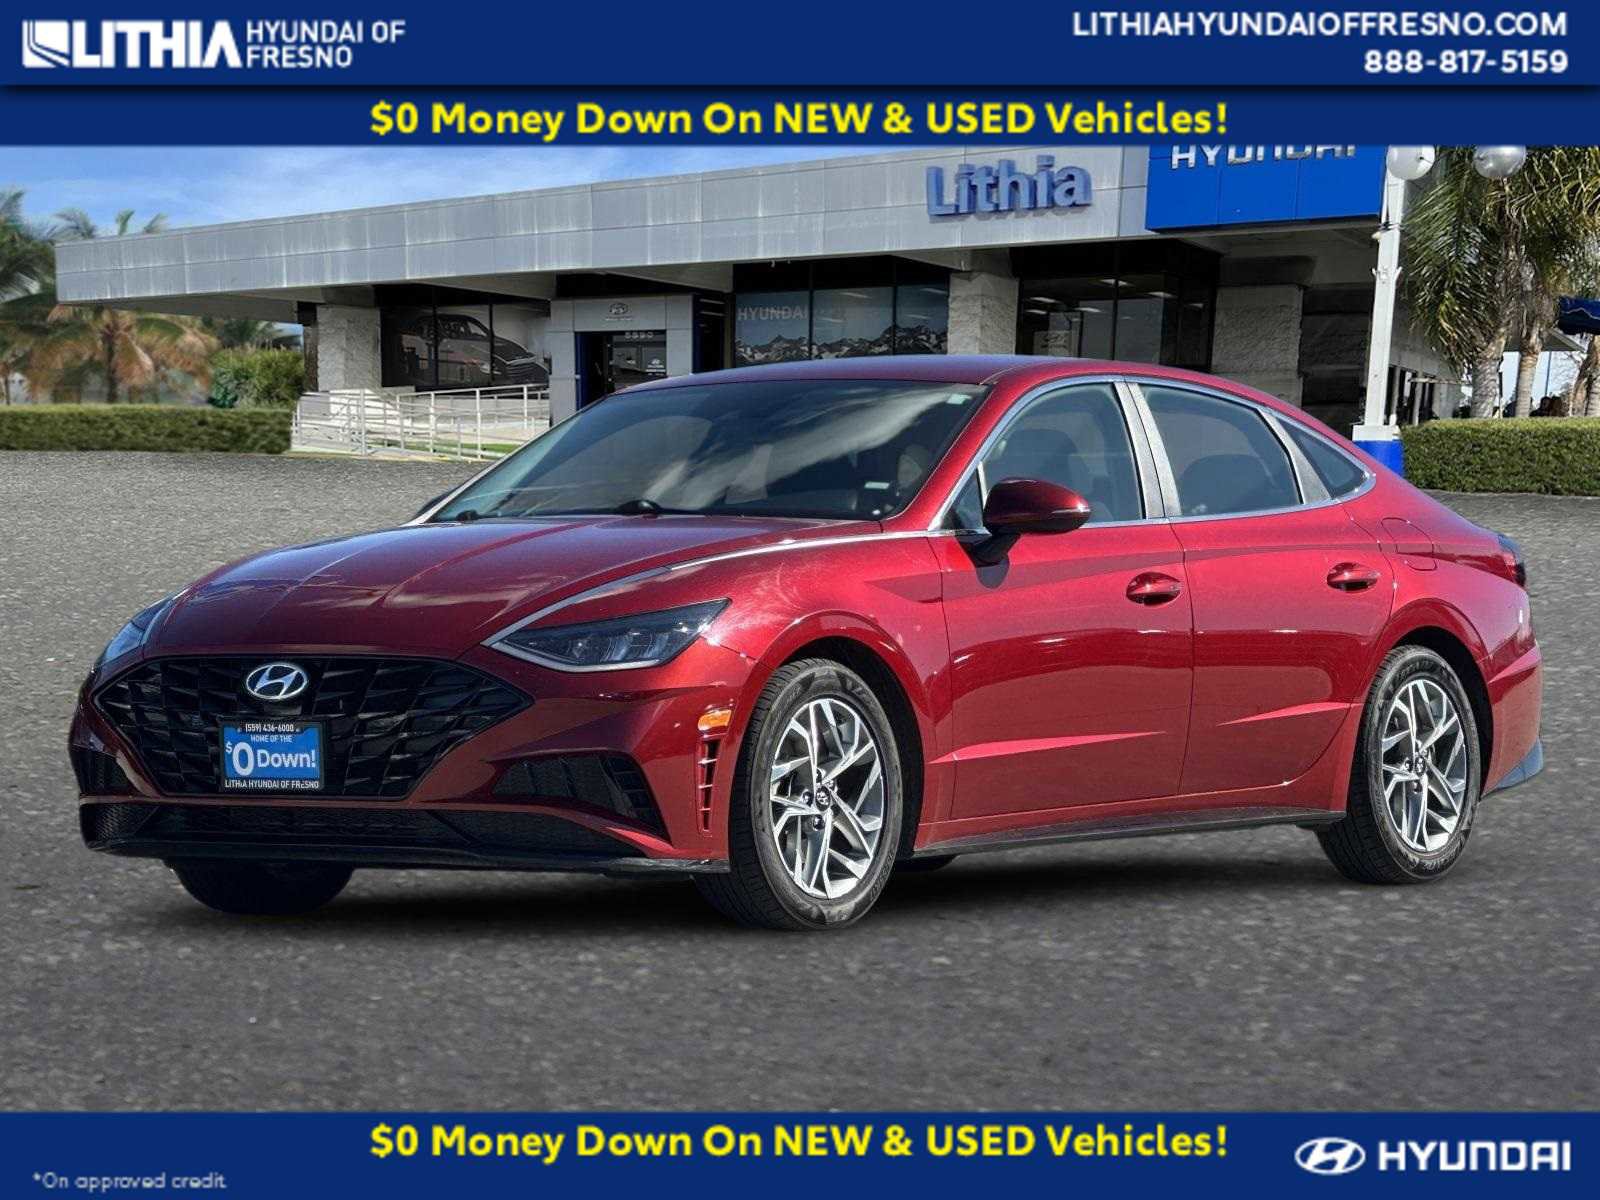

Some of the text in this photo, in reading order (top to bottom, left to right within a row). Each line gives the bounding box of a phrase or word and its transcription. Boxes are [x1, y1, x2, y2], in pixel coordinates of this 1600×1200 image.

[925, 154, 1093, 217] Lithia
[737, 304, 809, 321] HYUNDAI
[250, 735, 293, 743] HOME OF THE
[257, 749, 316, 768] Down!
[224, 780, 319, 789] LITHIA HYUNDAI OF FRESNO
